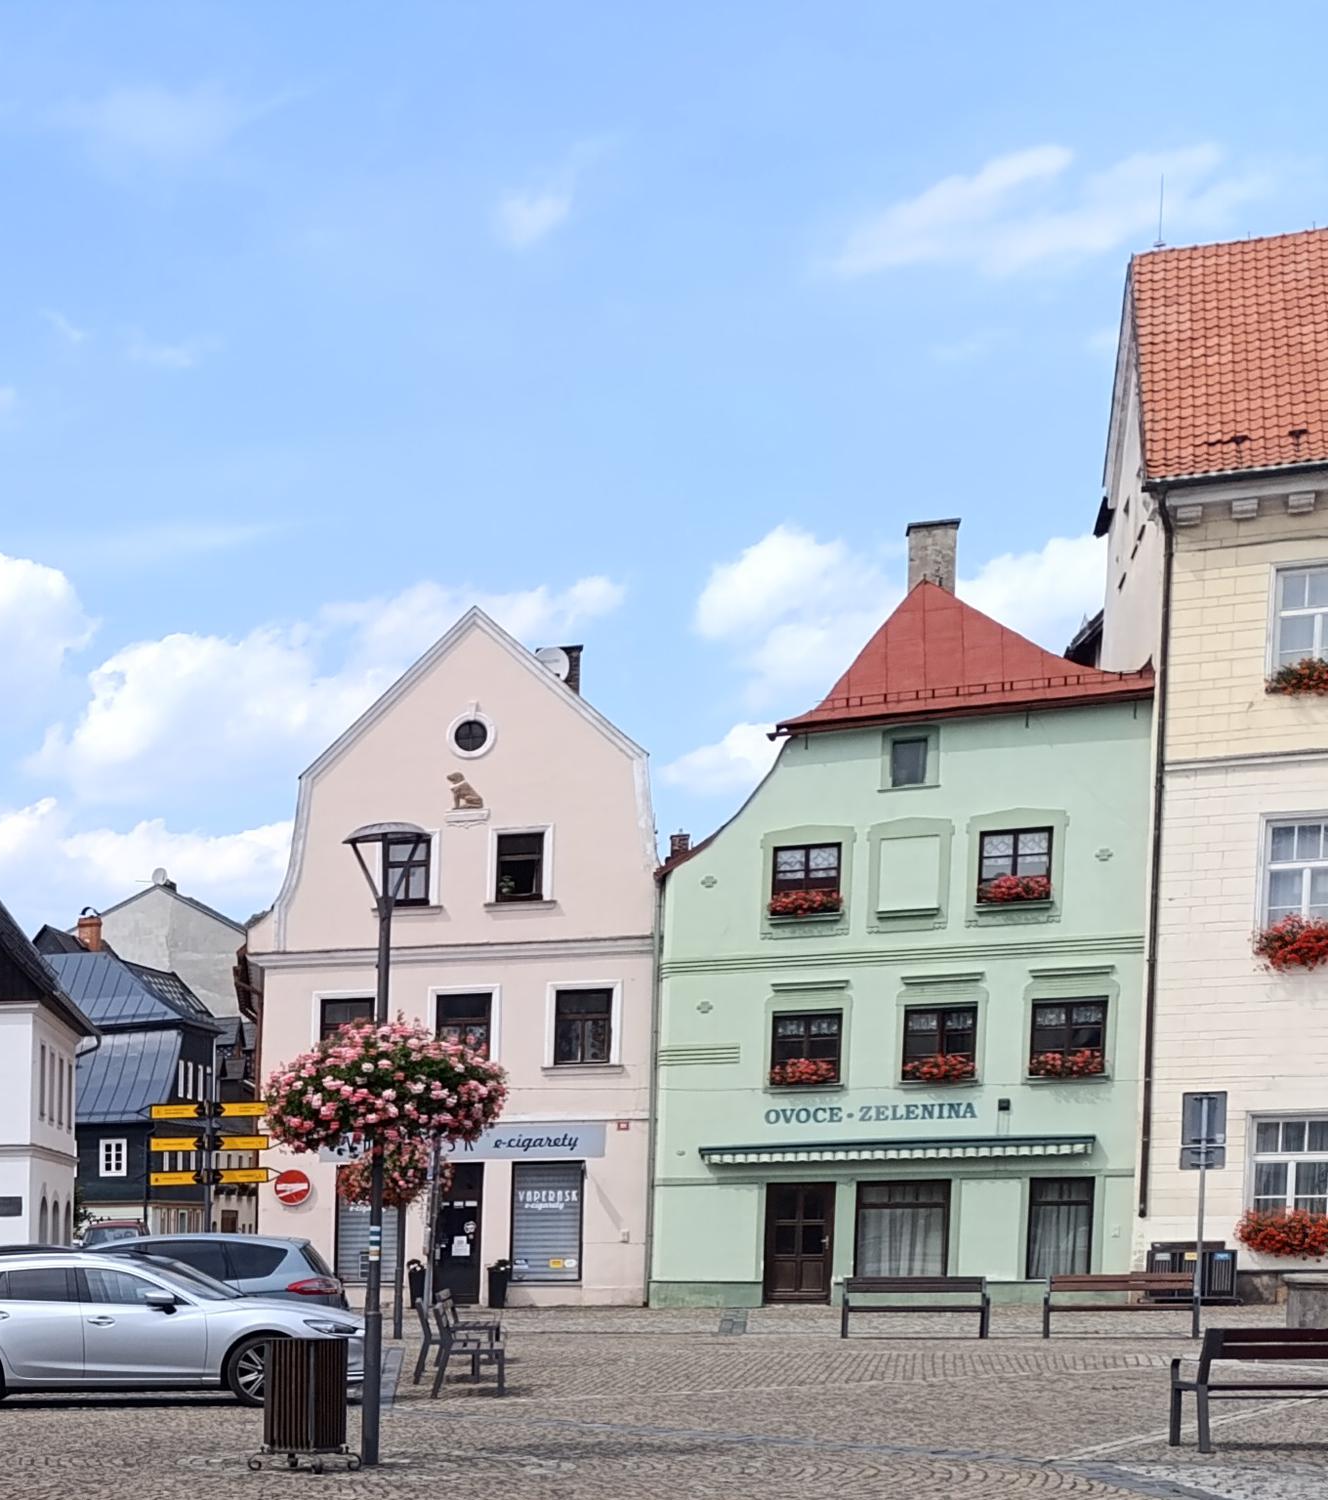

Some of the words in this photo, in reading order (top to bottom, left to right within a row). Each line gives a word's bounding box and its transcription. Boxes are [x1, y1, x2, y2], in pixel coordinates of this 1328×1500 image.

[765, 1107, 843, 1124] OVOCE
[859, 1102, 977, 1122] ZELENINA
[493, 1133, 579, 1152] e-cigarety
